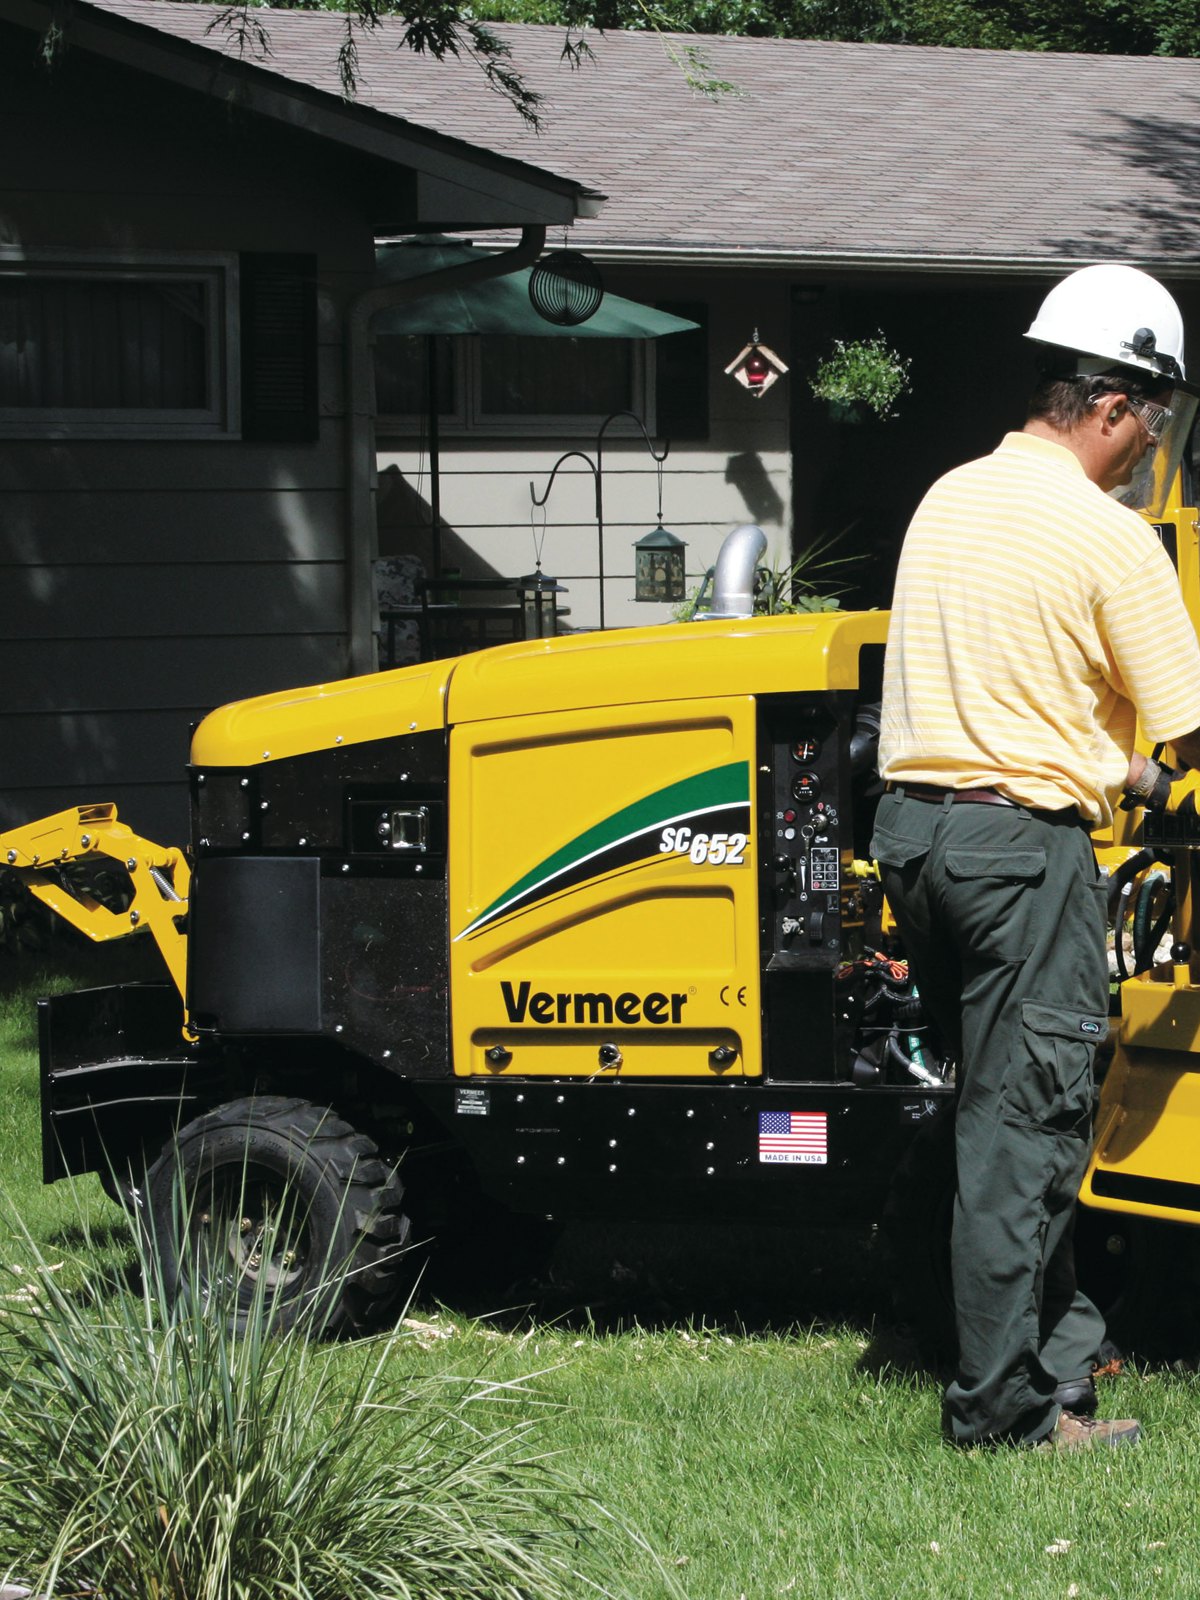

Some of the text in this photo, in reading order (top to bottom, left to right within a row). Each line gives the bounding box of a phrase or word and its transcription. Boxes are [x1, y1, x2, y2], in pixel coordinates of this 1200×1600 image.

[659, 827, 747, 865] SC652
[500, 981, 688, 1024] Vermeer
[765, 1154, 789, 1162] MADE
